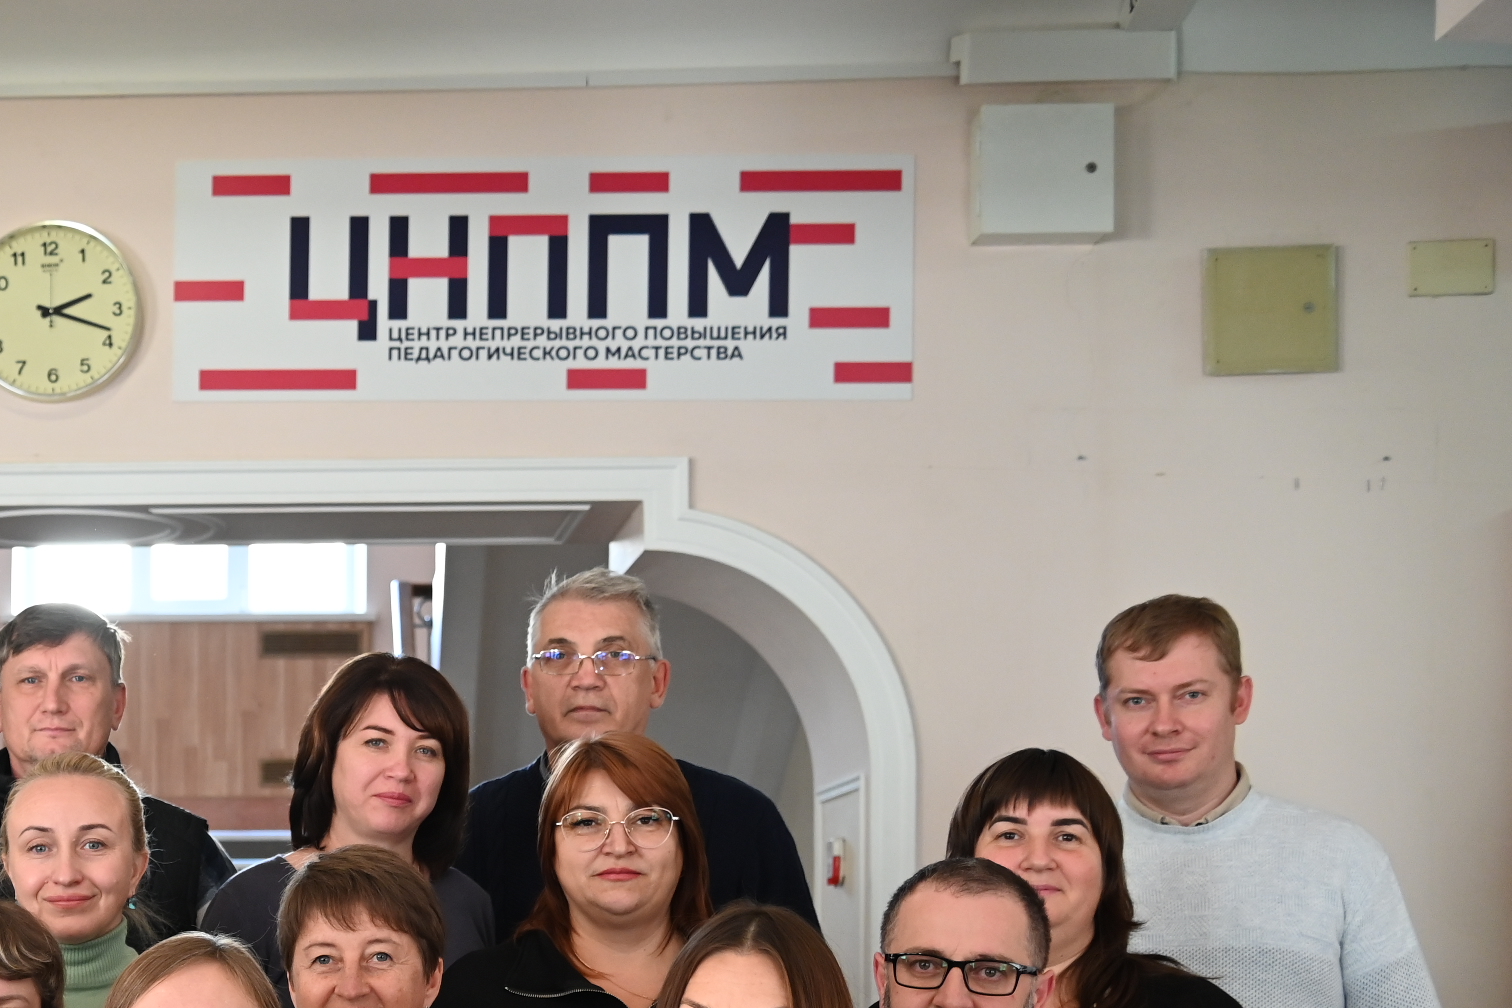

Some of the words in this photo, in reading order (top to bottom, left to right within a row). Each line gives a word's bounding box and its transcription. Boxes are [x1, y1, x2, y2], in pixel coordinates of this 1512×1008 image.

[41, 241, 59, 256] 12
[79, 248, 86, 263] 1
[11, 251, 26, 266] 11
[101, 269, 113, 285] 2
[289, 213, 789, 340] ЦНППМ
[112, 301, 123, 317] 3
[102, 334, 114, 349] 4
[388, 327, 458, 344] ЦЕНТР
[463, 326, 638, 341] НЕПРЕРЫВНОГО
[644, 326, 788, 341] ПОВЫШЕНИЯ
[388, 346, 599, 364] ПЕДАГОГИЧЕСКОГО
[605, 346, 744, 361] МАСТЕРСТВА
[15, 360, 27, 375] 7
[79, 358, 91, 373] 5
[47, 368, 59, 383] 6
